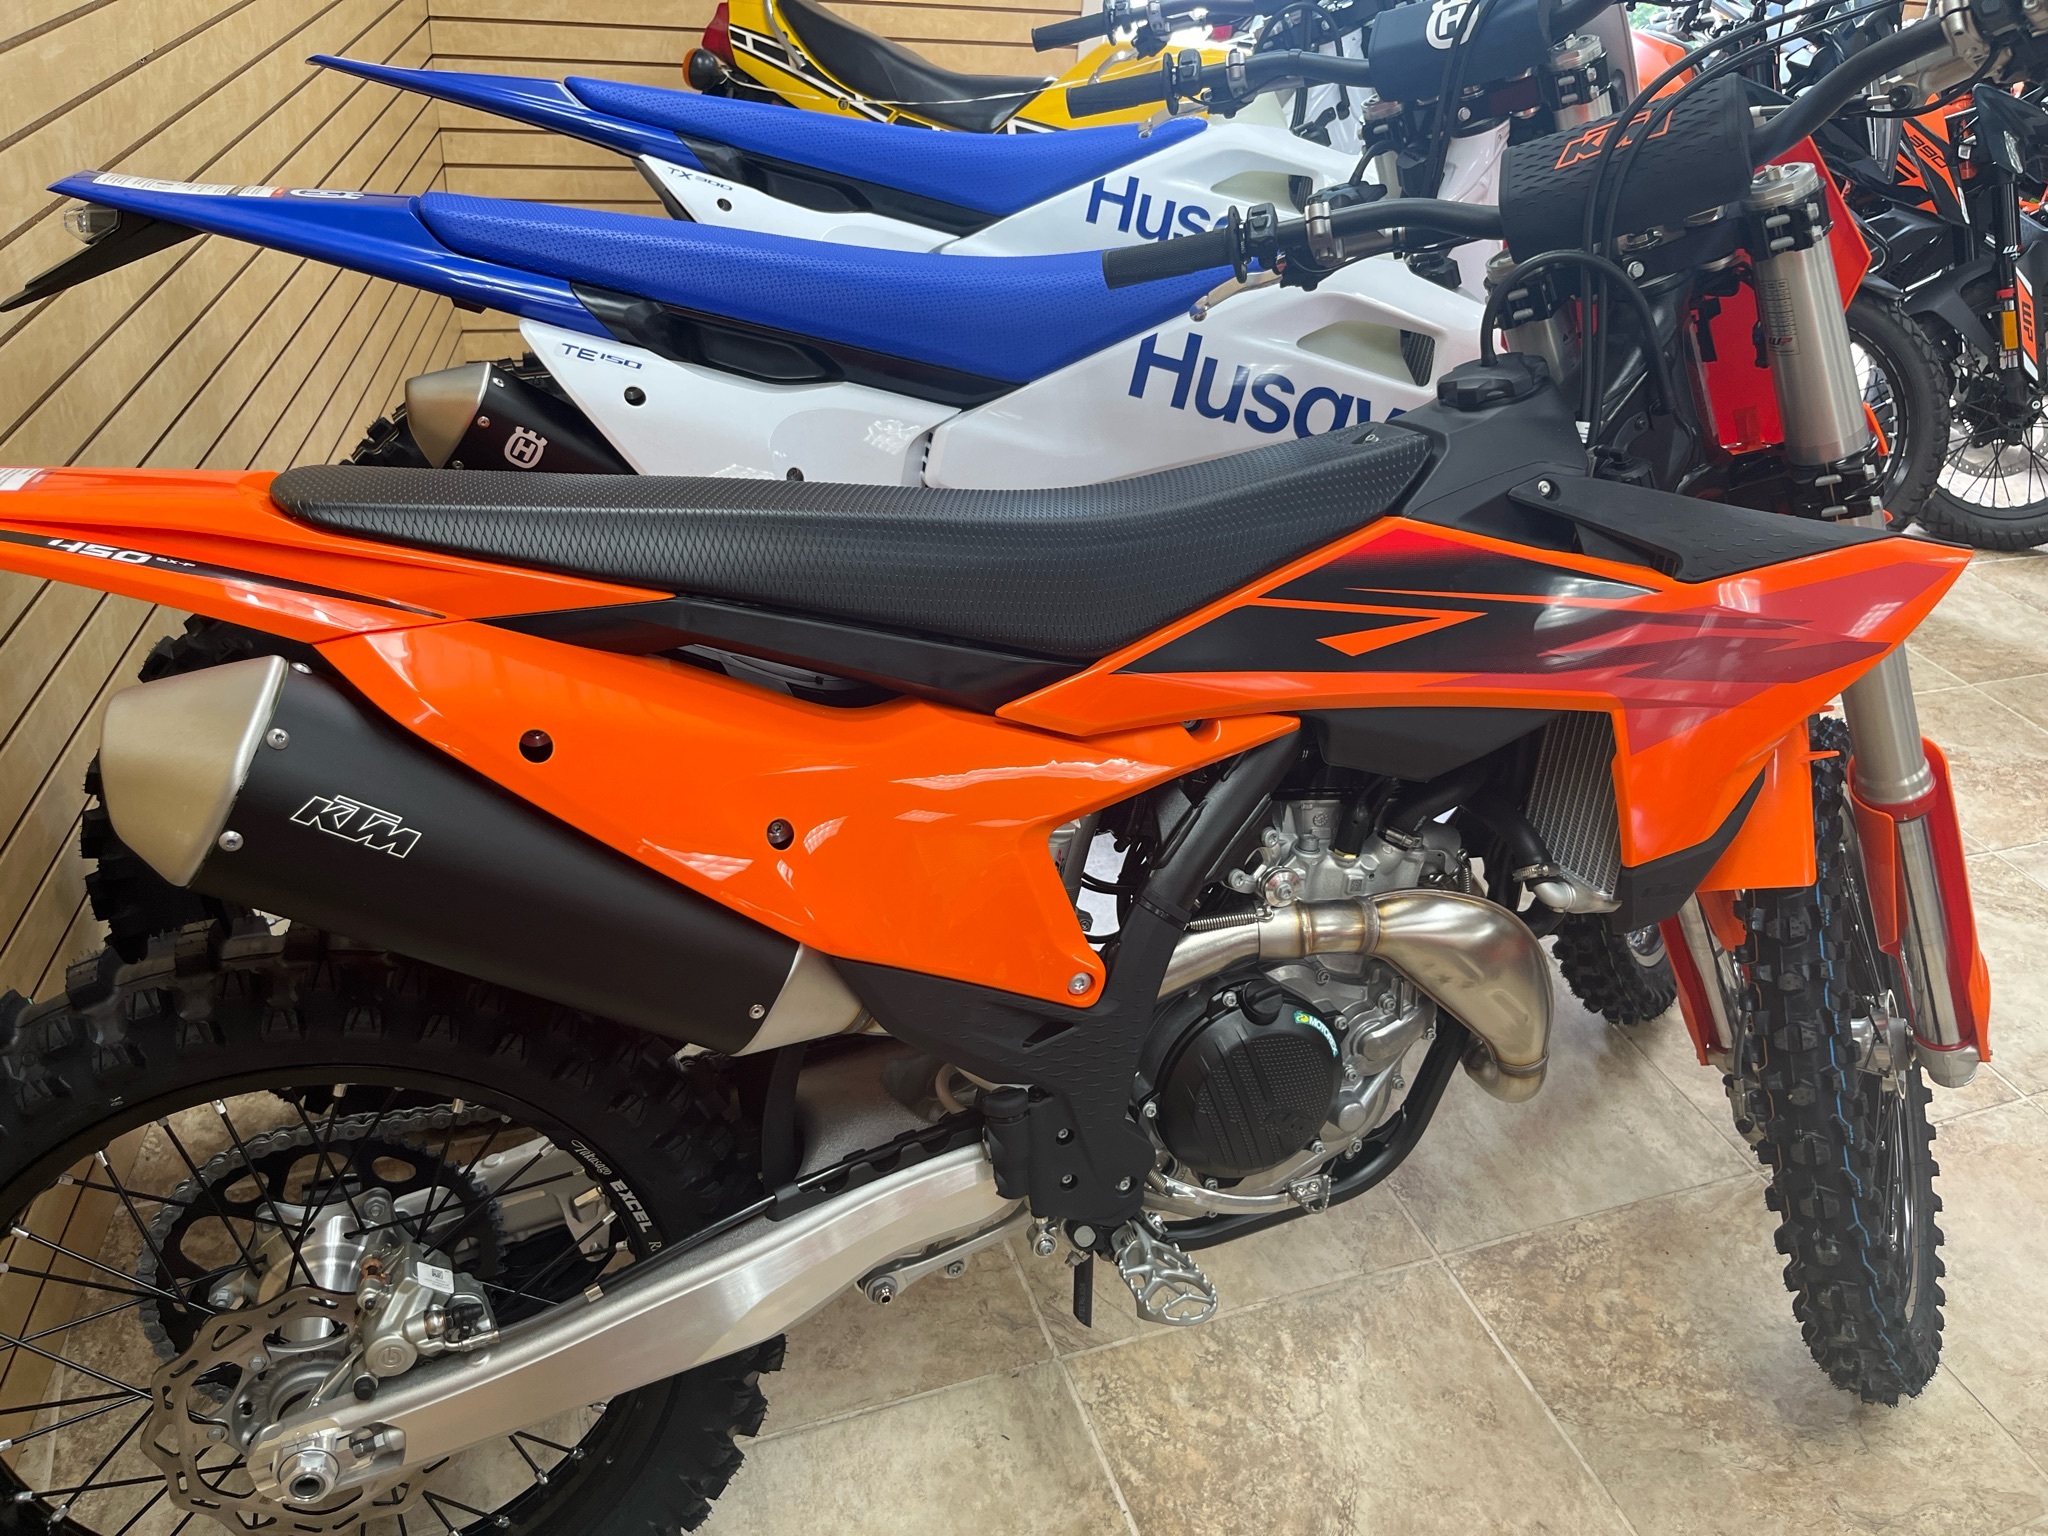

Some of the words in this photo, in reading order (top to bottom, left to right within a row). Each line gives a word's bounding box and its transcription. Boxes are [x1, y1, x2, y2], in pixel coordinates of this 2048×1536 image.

[1909, 134, 1947, 169] 390
[668, 166, 693, 181] TX
[694, 175, 733, 191] 300
[1085, 175, 1229, 241] Hus
[2021, 301, 2034, 343] WP
[562, 342, 598, 362] TE
[600, 353, 643, 369] 150
[48, 539, 152, 564] 450
[289, 794, 422, 858] KTM
[571, 1139, 613, 1176] Takasago
[609, 1178, 653, 1233] EXCEL
